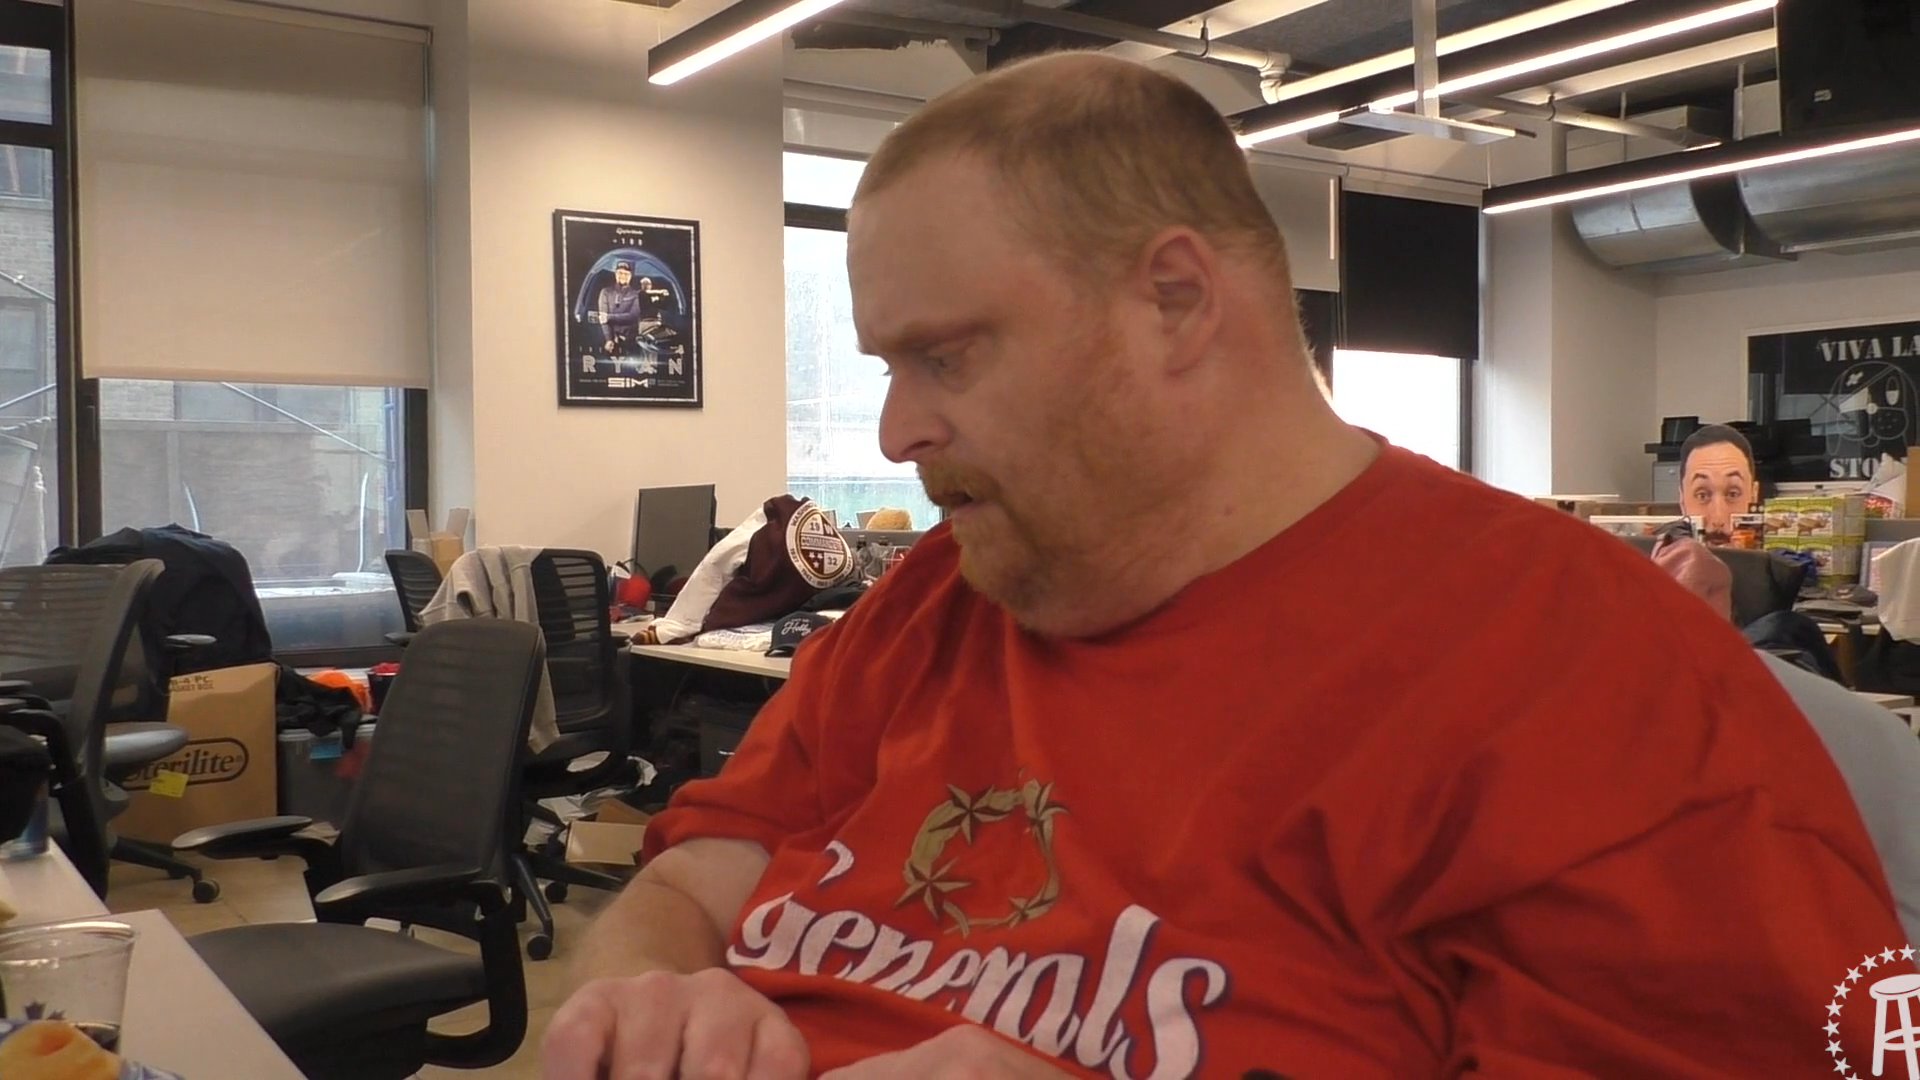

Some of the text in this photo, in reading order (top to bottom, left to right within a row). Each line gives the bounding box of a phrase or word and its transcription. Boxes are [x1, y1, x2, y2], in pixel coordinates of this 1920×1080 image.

[1820, 334, 1920, 362] VIVA LA
[827, 556, 838, 566] 32
[726, 891, 1228, 1080] generals
